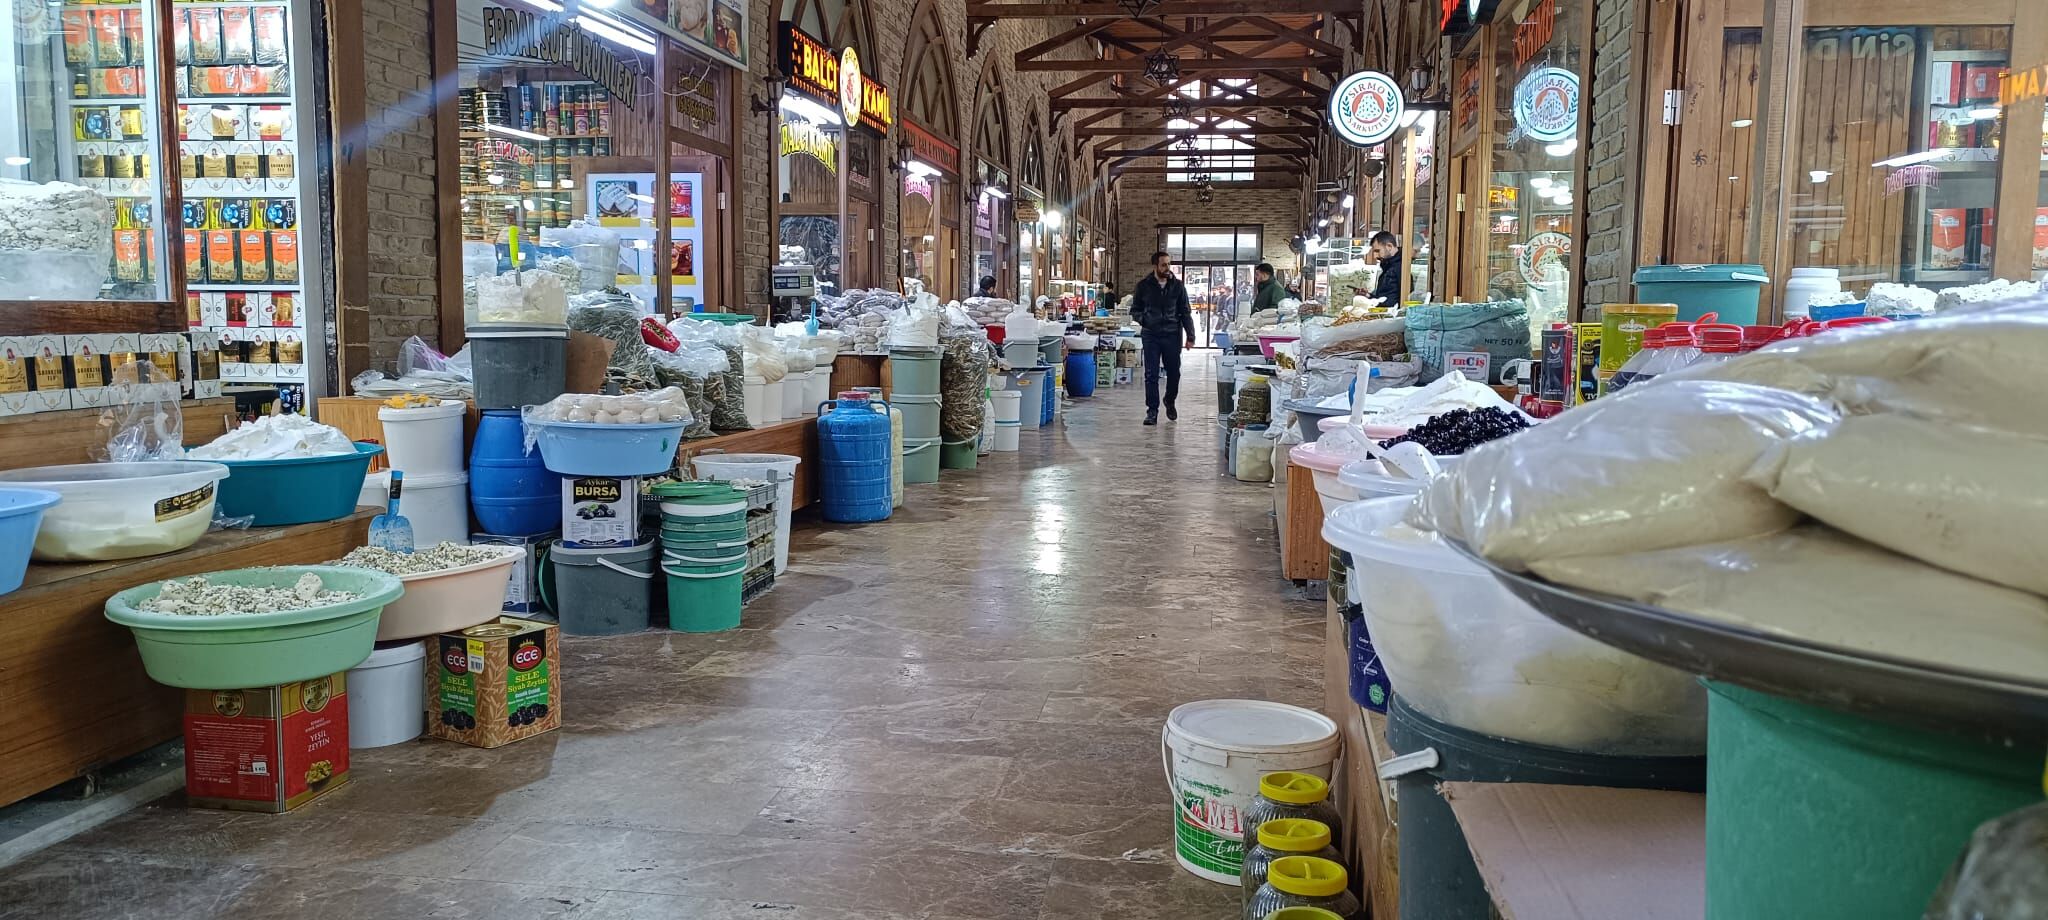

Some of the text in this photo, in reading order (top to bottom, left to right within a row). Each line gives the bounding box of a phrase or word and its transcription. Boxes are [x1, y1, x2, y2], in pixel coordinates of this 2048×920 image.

[483, 7, 538, 58] ERDAL
[539, 10, 571, 66] SÜT
[571, 22, 639, 112] ÜRÜNLERİ
[803, 44, 838, 93] BALCI
[863, 80, 893, 125] KAMİL
[1348, 82, 1386, 99] SIRMO
[1532, 236, 1571, 252] SIRMO
[1501, 338, 1513, 346] 50
[575, 486, 619, 497] BURSA
[447, 654, 467, 667] ECE
[516, 649, 539, 664] ECE
[514, 671, 541, 684] SELE
[507, 682, 526, 694] Siyah
[526, 678, 548, 690] Zeytin
[309, 729, 328, 742] YEŞİL
[307, 737, 331, 753] ZEYTİN
